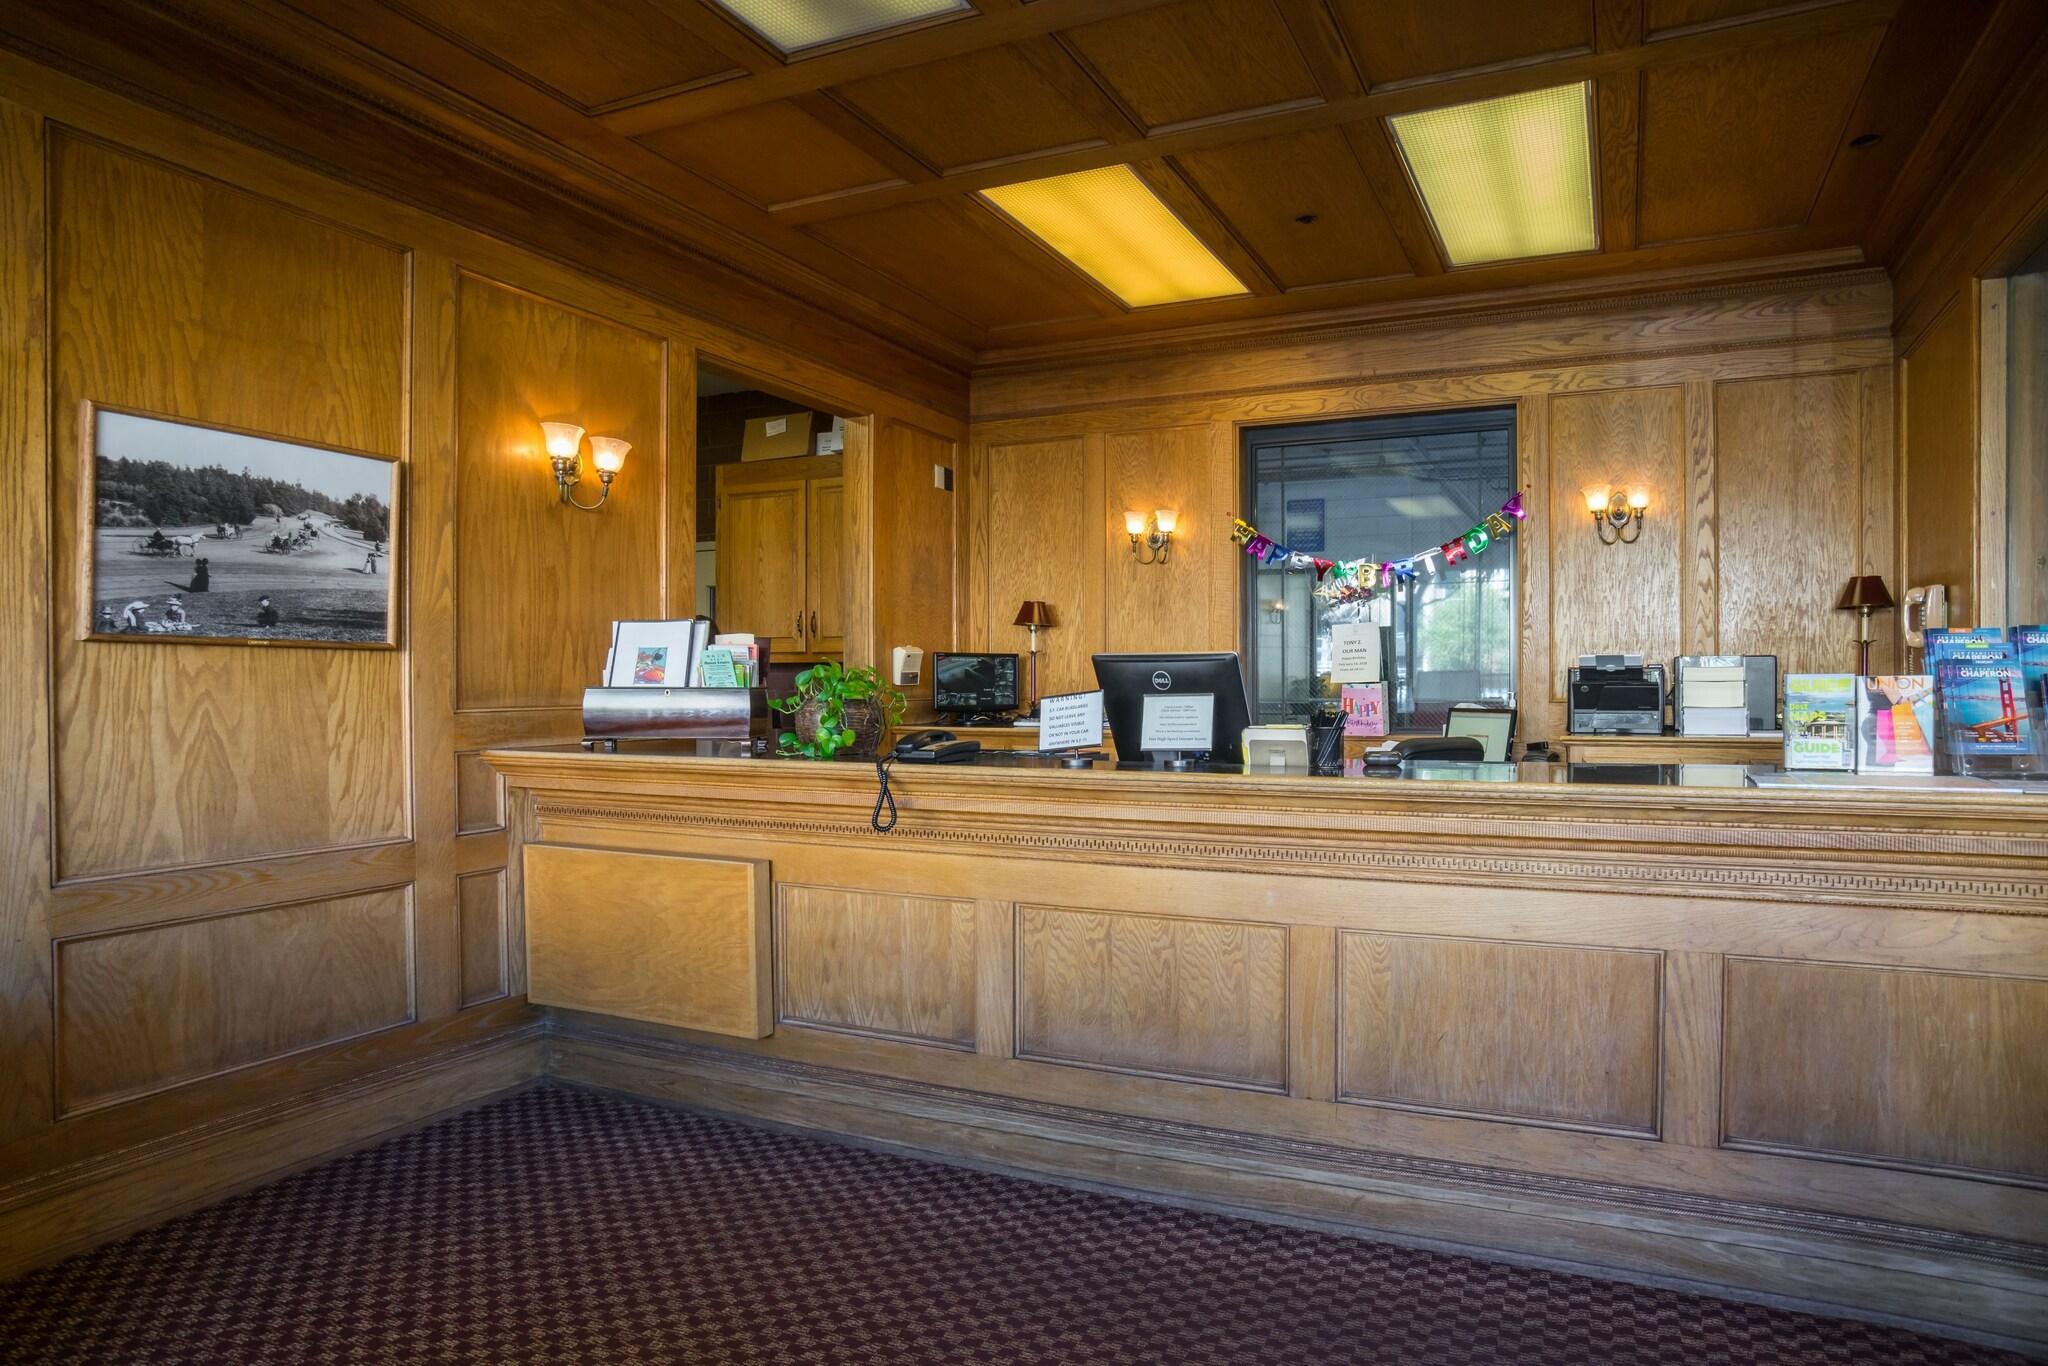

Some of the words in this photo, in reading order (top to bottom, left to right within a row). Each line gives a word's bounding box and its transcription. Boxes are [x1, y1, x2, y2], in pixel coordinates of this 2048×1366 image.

[1960, 670, 2012, 678] CHAPERON
[1867, 677, 1925, 690] UNION
[1343, 697, 1380, 717] HAPPY
[1793, 742, 1841, 753] GUIDE
